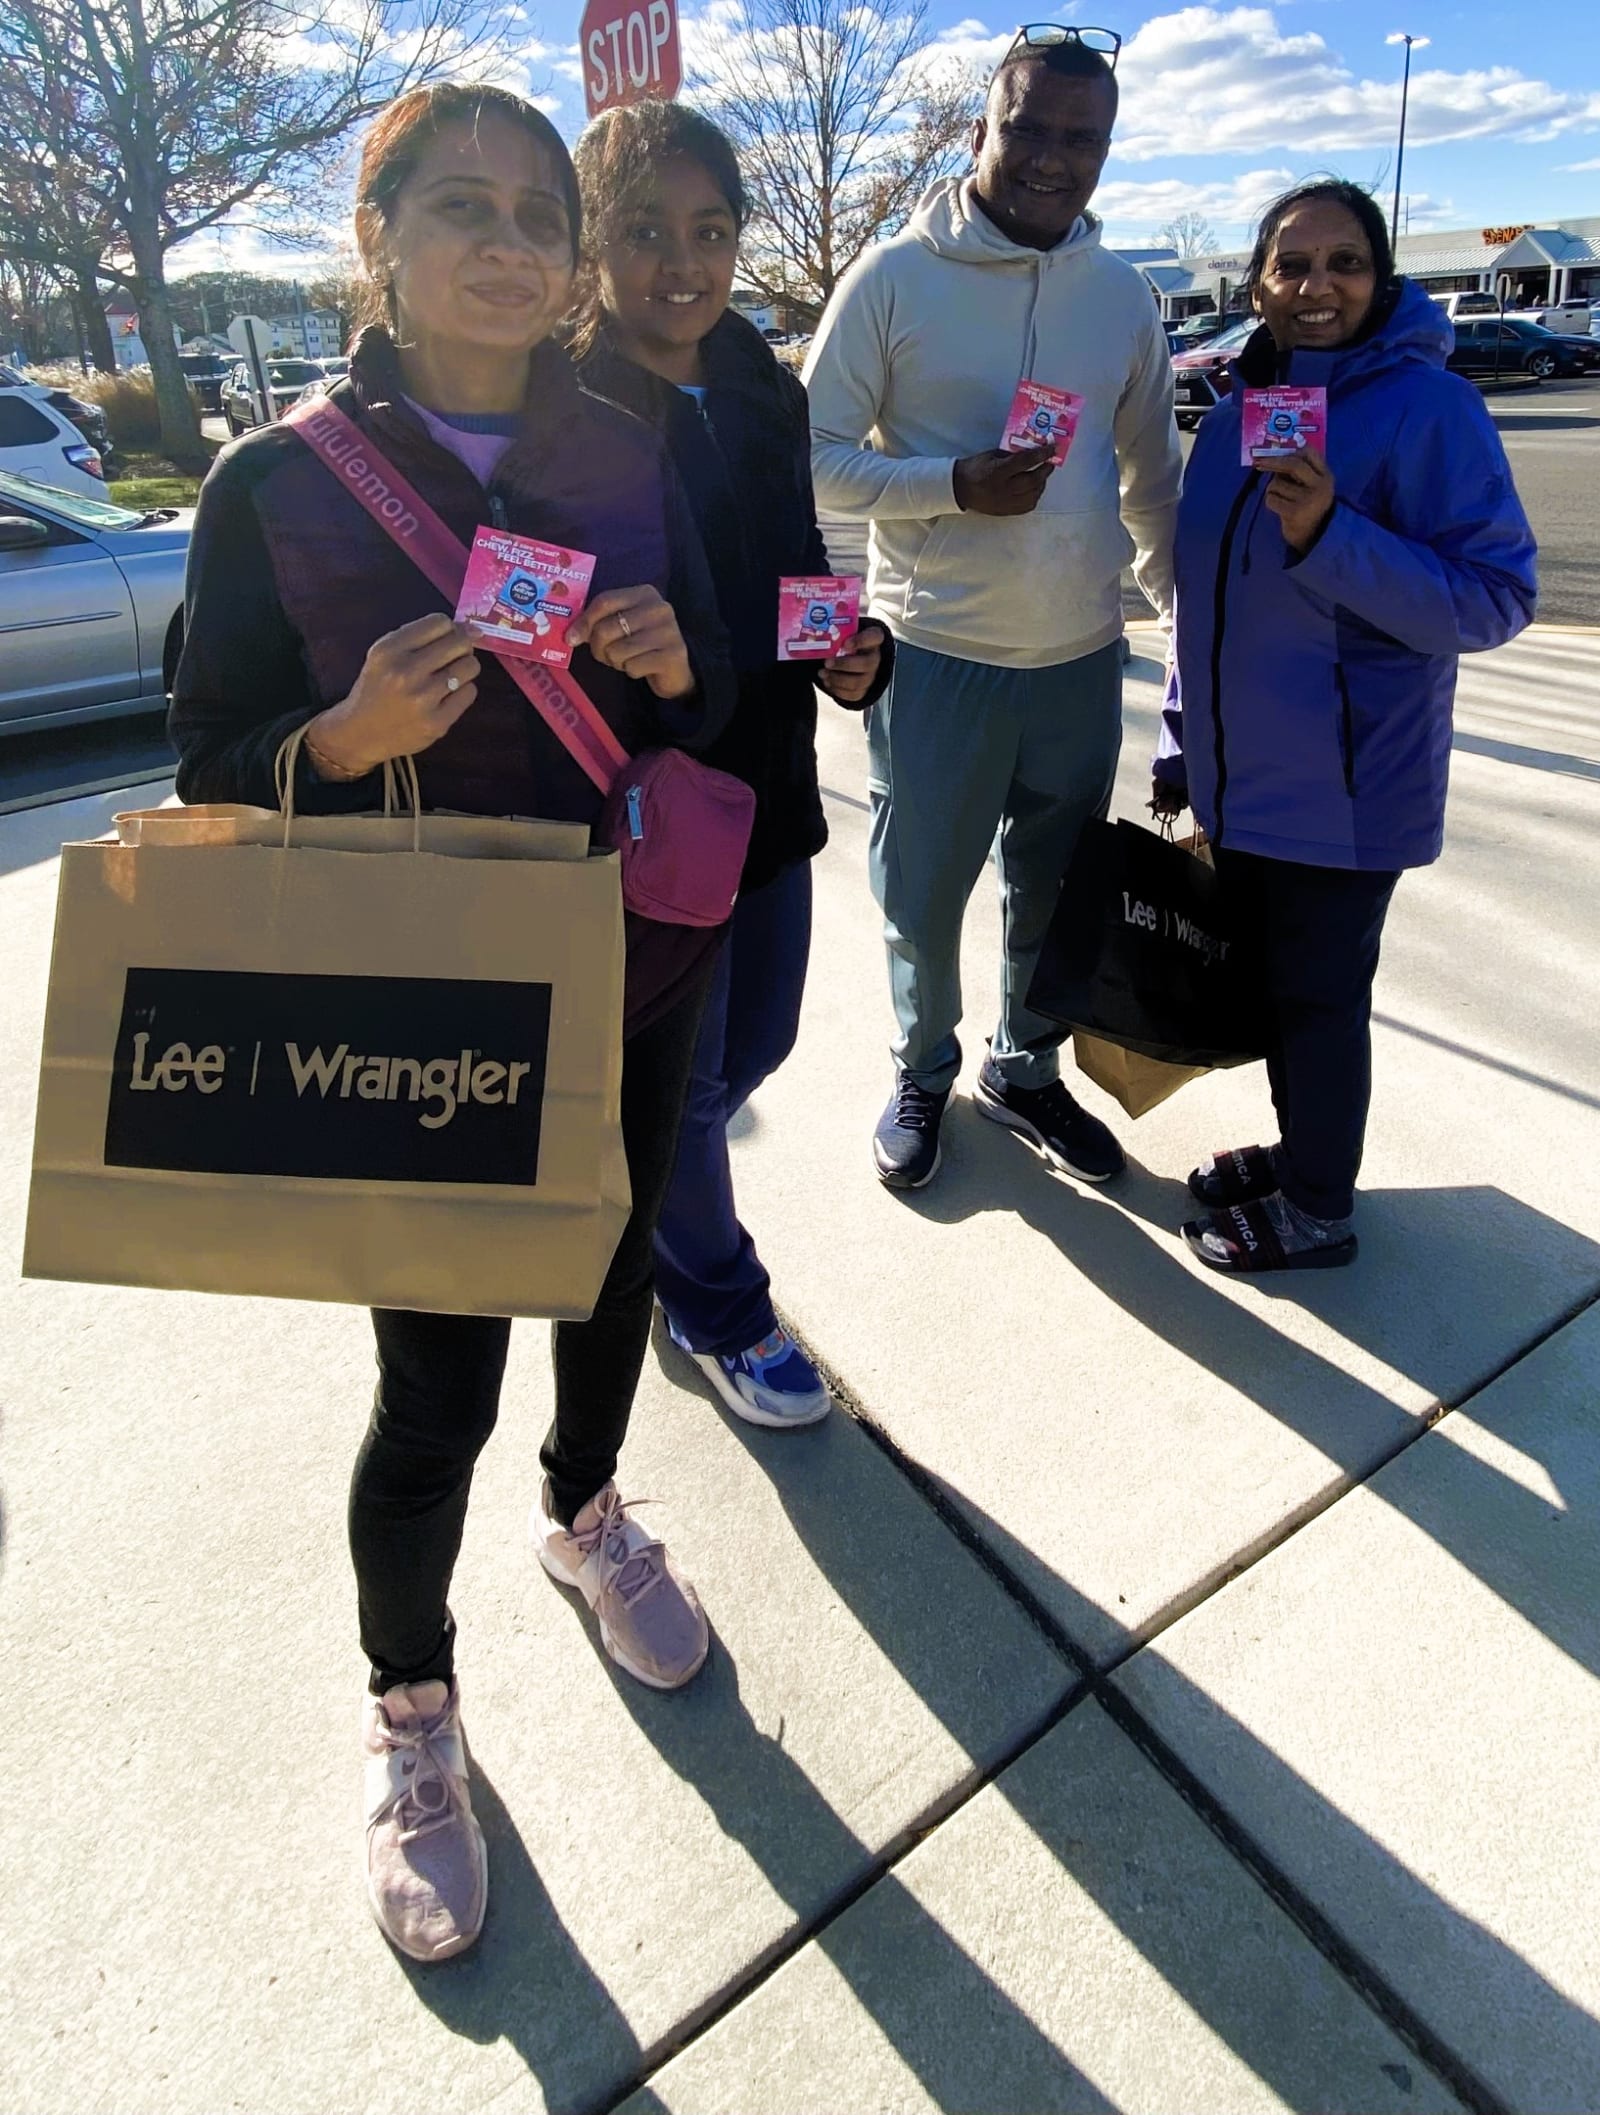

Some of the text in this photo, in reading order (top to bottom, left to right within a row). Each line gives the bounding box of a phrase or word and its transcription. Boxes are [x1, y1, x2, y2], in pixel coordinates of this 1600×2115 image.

[588, 0, 670, 103] STOP
[306, 410, 419, 537] ululemon
[497, 552, 590, 582] FEEL BETTER FAST!
[1122, 891, 1157, 931] Lee
[129, 1032, 531, 1130] Lee Wrangler
